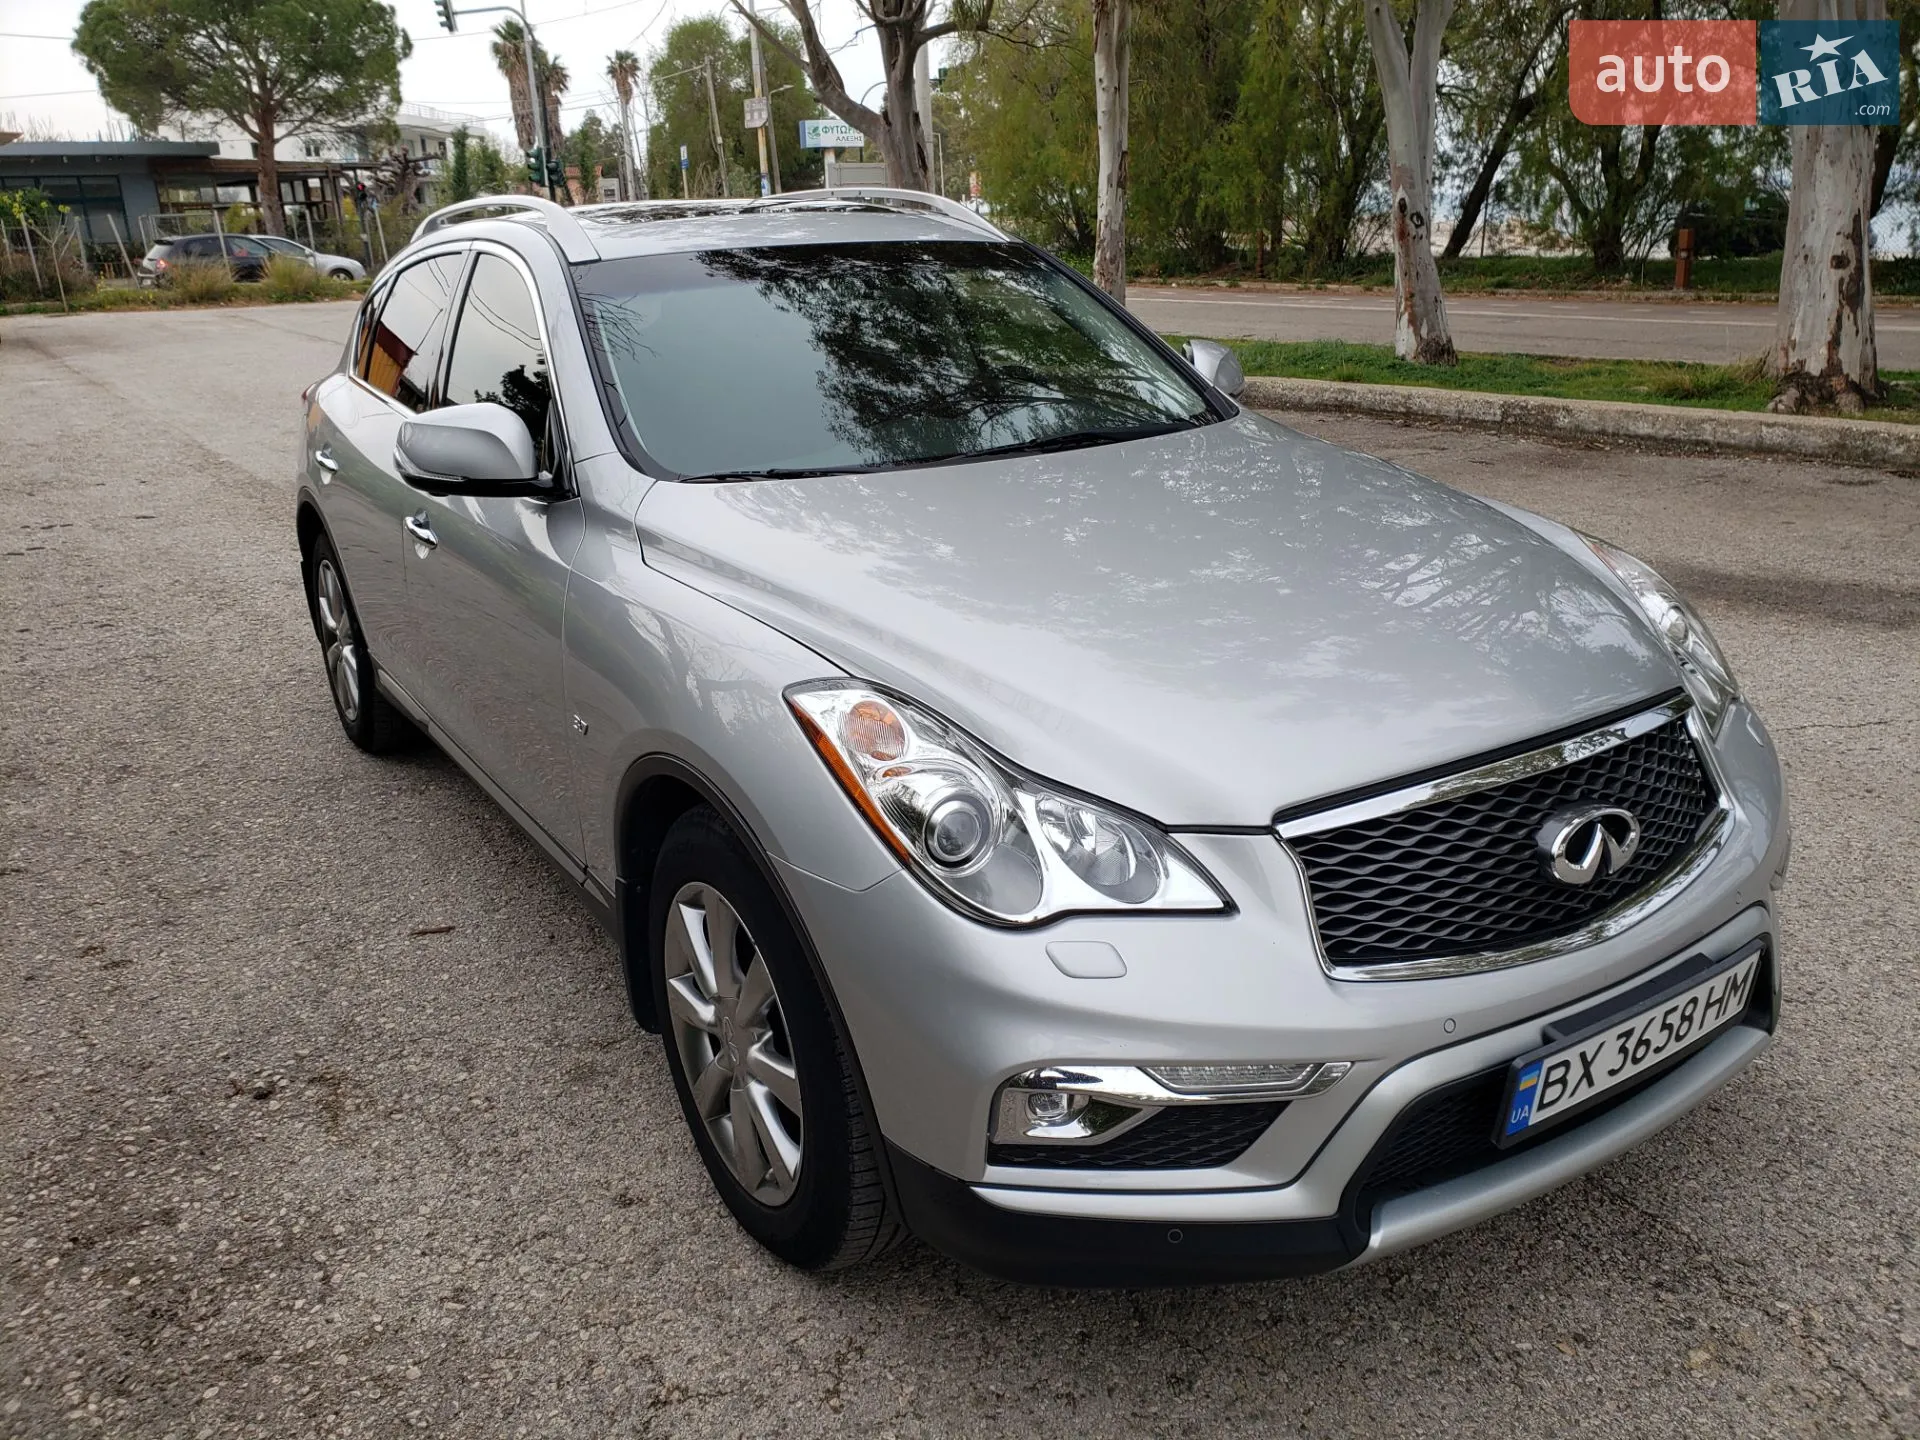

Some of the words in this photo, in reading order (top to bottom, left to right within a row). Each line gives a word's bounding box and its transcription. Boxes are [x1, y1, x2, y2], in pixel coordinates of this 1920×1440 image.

[1536, 1041, 1606, 1113] BX
[1607, 996, 1700, 1077] 3658
[1699, 961, 1755, 1031] HM
[1511, 1104, 1529, 1124] UA
